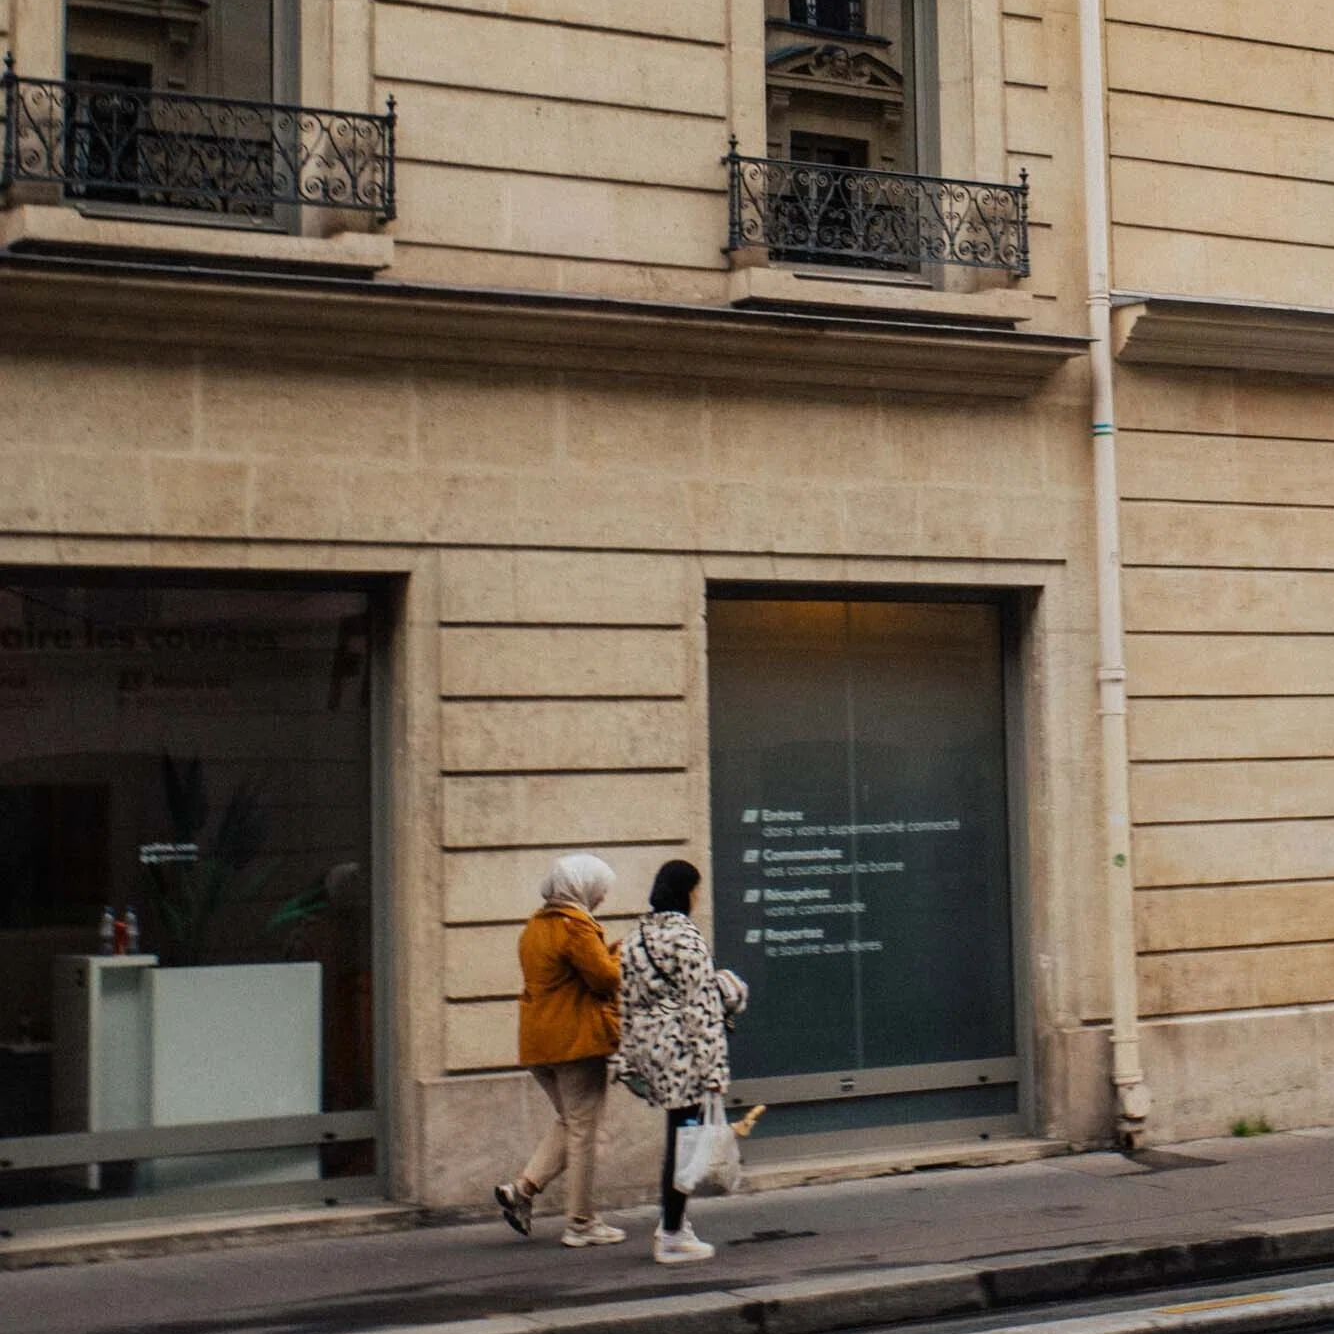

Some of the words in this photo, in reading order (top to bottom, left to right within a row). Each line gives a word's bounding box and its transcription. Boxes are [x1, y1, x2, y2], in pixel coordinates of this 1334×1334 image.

[84, 618, 135, 648] les
[147, 625, 279, 653] courses
[761, 809, 804, 822] Entrez
[761, 824, 793, 837] dans
[795, 824, 827, 836] votre
[828, 820, 904, 836] supermarché
[907, 818, 961, 832] connecté
[763, 847, 844, 861] Commandez
[763, 867, 785, 877] vos
[786, 865, 833, 876] courses
[834, 864, 853, 874] sur
[869, 860, 905, 873] borne
[763, 886, 832, 902] Récupérez
[764, 905, 796, 917] votre
[797, 902, 867, 916] commande
[779, 944, 820, 957] sourire
[821, 942, 846, 954] aux
